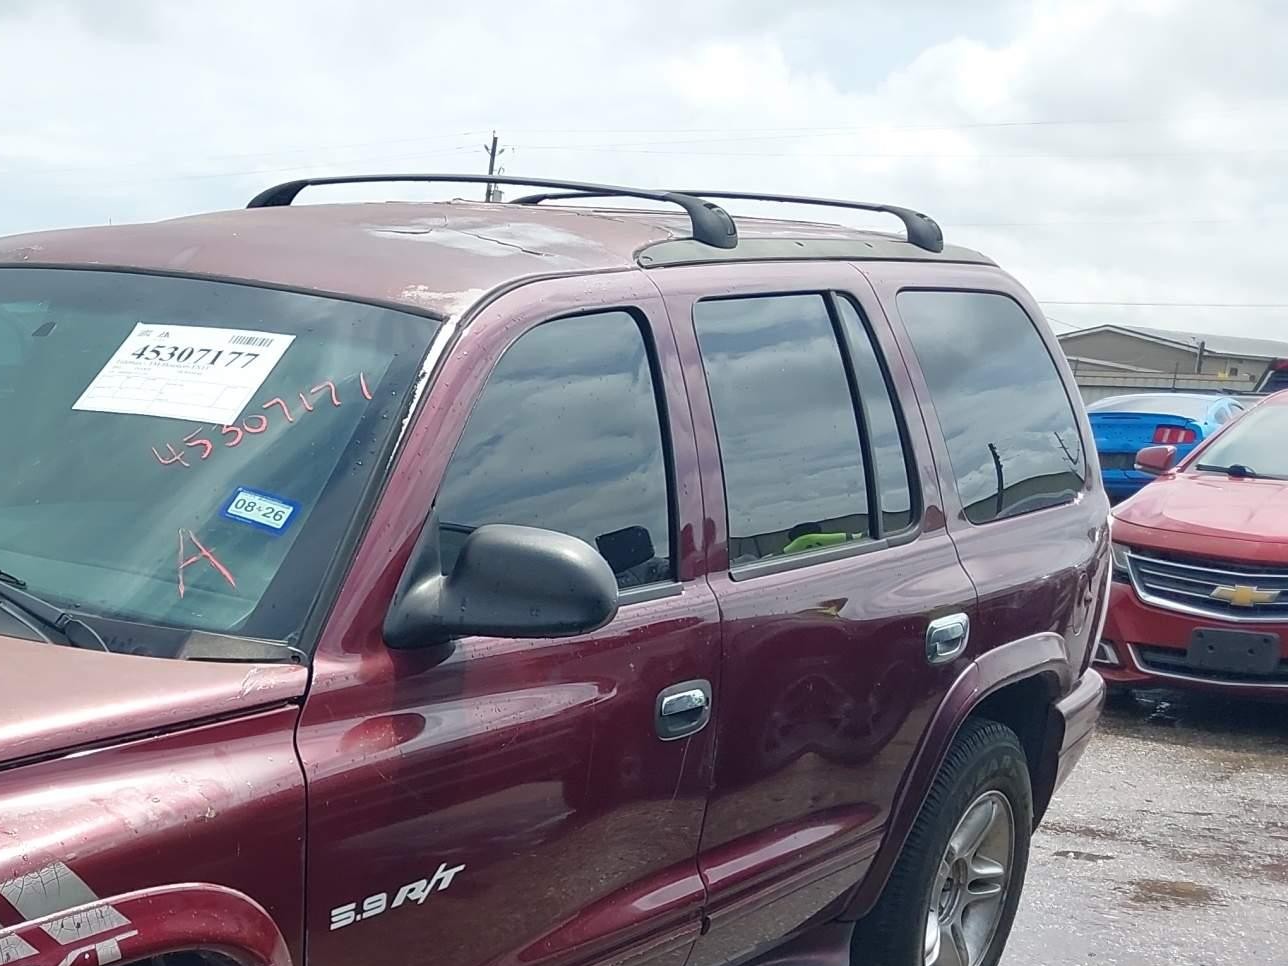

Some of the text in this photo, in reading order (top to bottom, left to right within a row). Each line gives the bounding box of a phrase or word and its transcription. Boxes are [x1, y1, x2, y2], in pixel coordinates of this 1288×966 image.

[130, 344, 260, 369] 45307177
[177, 528, 237, 600] A
[330, 862, 466, 931] 5.9 R/T
